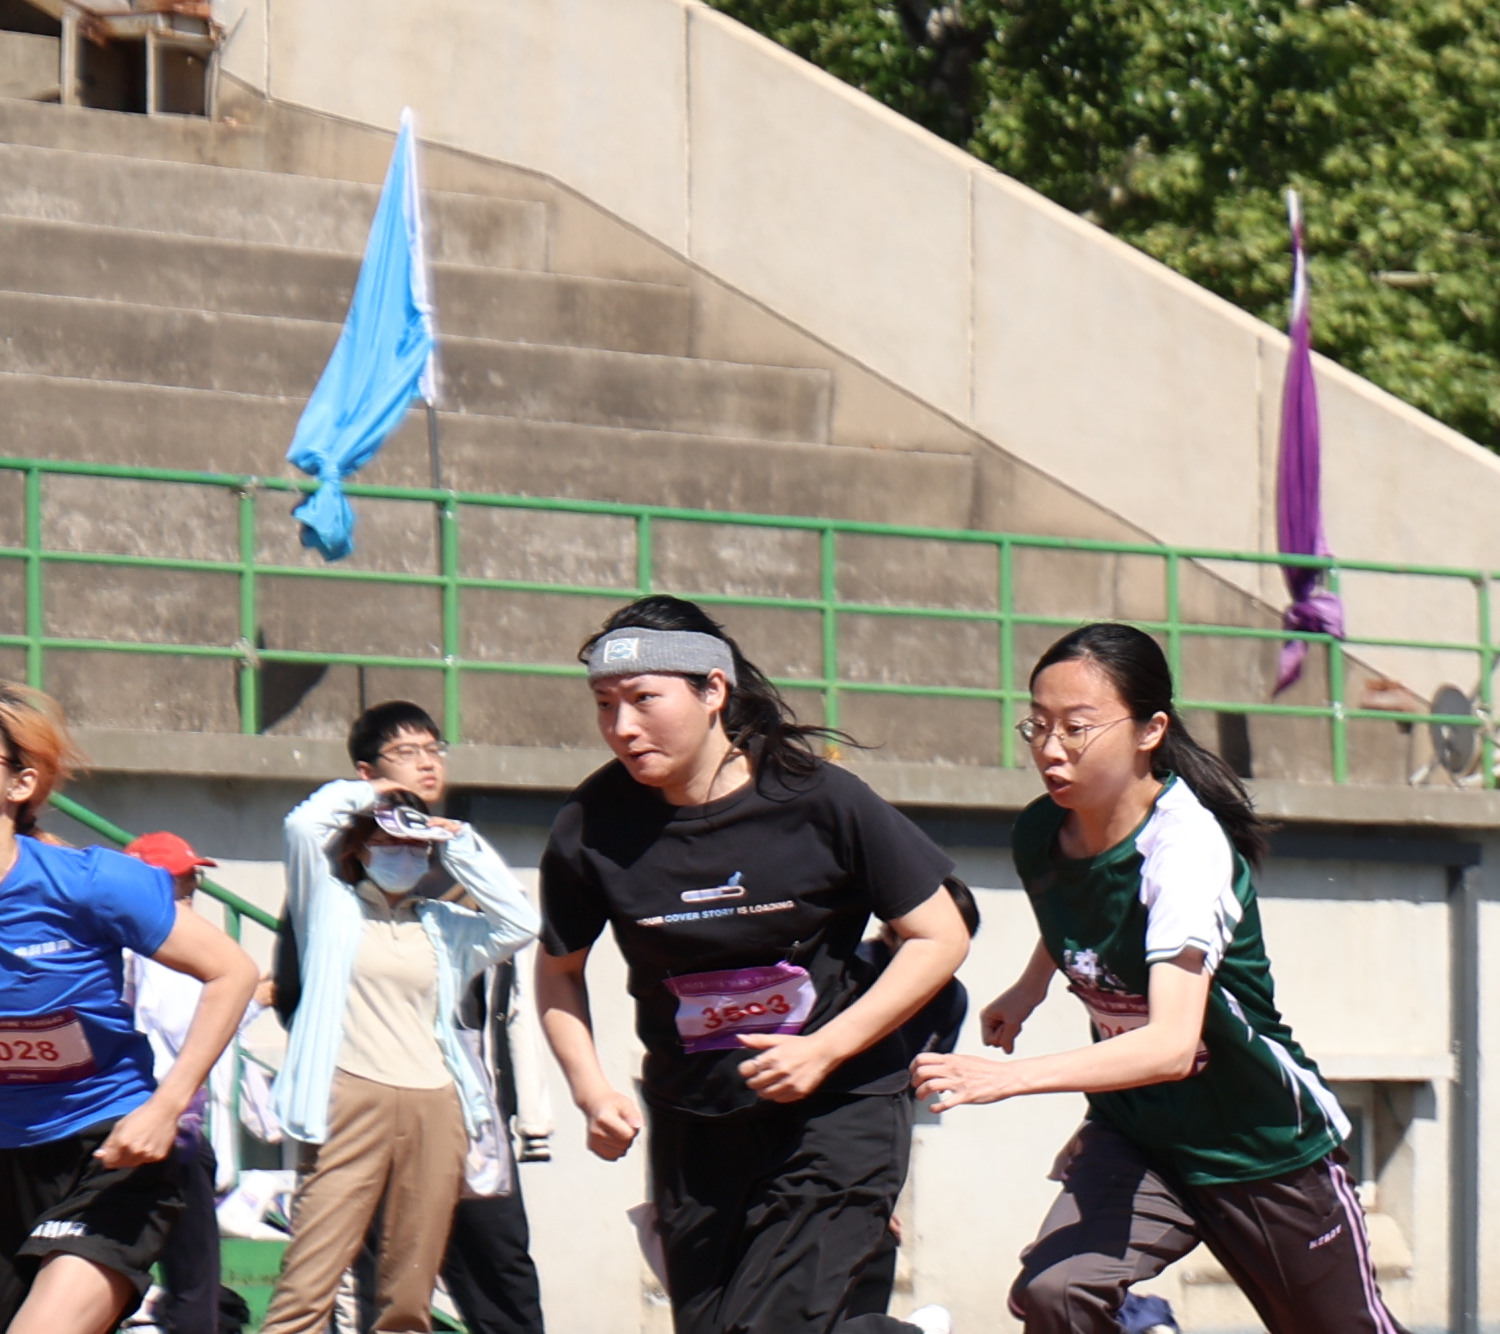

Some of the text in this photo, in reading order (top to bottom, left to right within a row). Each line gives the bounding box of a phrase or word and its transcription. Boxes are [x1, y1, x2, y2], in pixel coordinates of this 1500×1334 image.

[664, 911, 700, 923] COVER
[701, 908, 735, 919] STORY
[737, 906, 748, 915] IS
[749, 900, 796, 914] LOADING
[701, 994, 791, 1029] 3503
